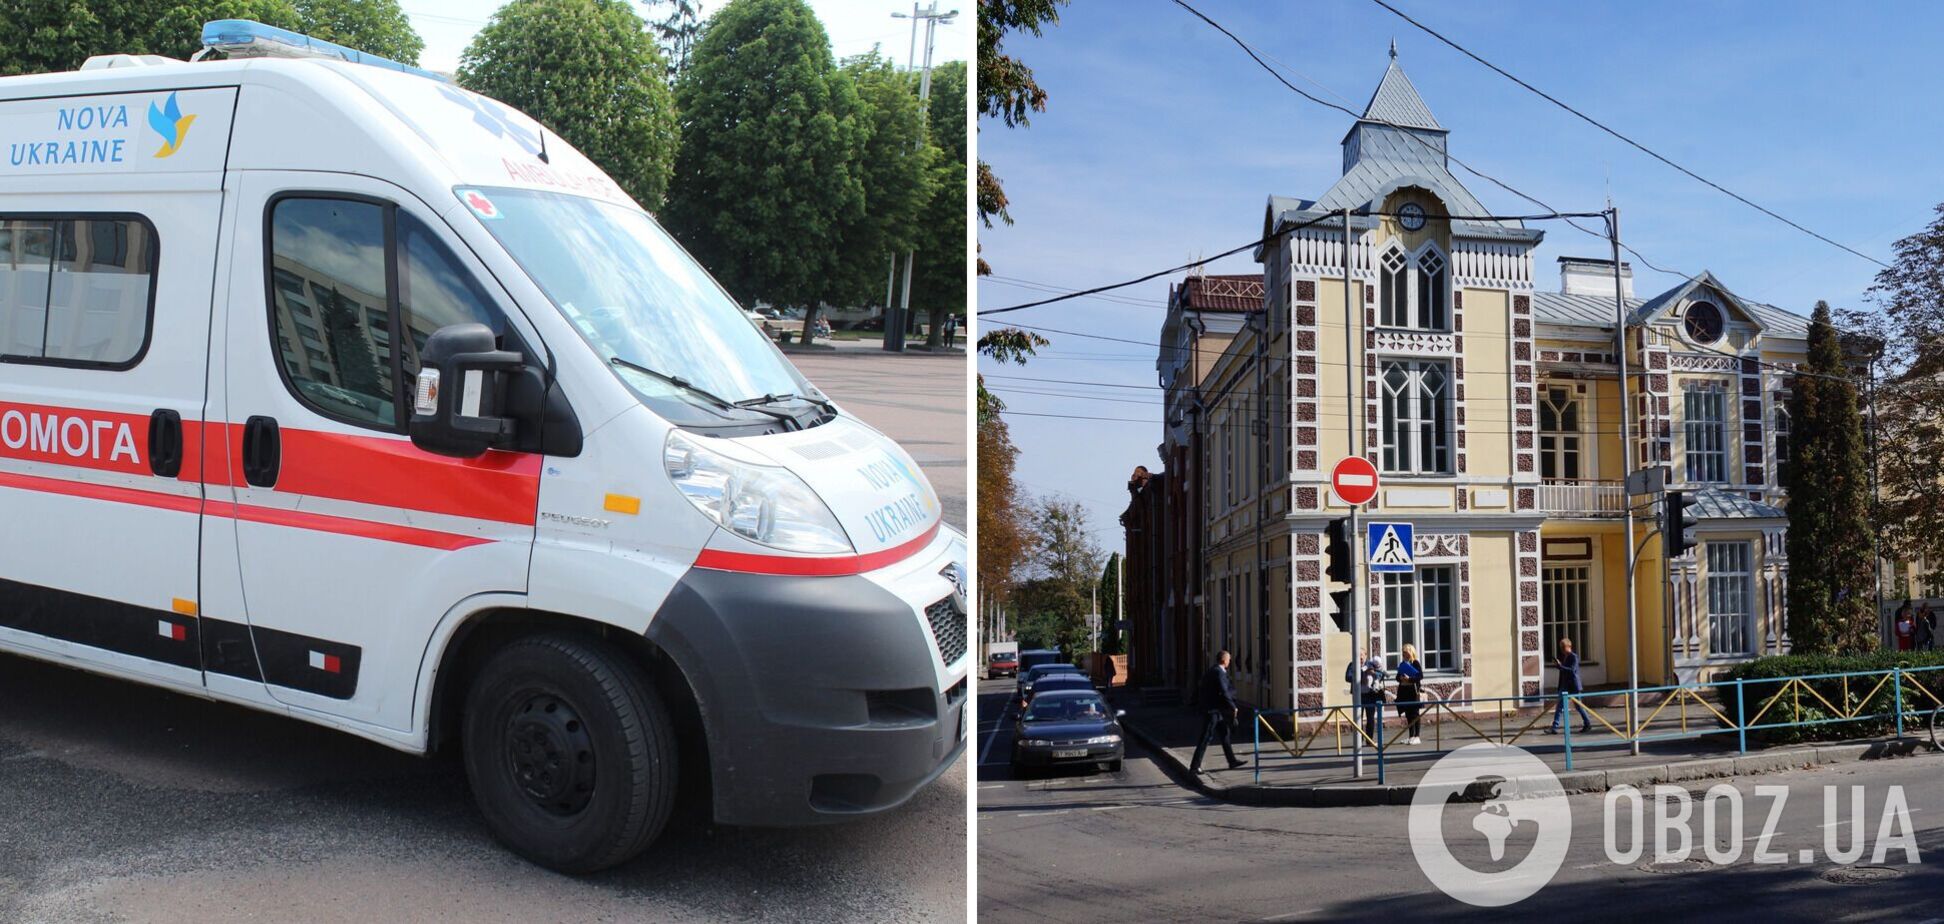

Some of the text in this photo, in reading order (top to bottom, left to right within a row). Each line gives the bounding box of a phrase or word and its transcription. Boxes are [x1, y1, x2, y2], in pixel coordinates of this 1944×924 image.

[58, 105, 128, 131] NOVA
[11, 139, 126, 166] UKRAINE
[1, 410, 140, 464] ОМОГА
[856, 460, 902, 491] NOVA
[541, 511, 613, 529] PEUGEOT
[864, 494, 927, 542] UKRAINE
